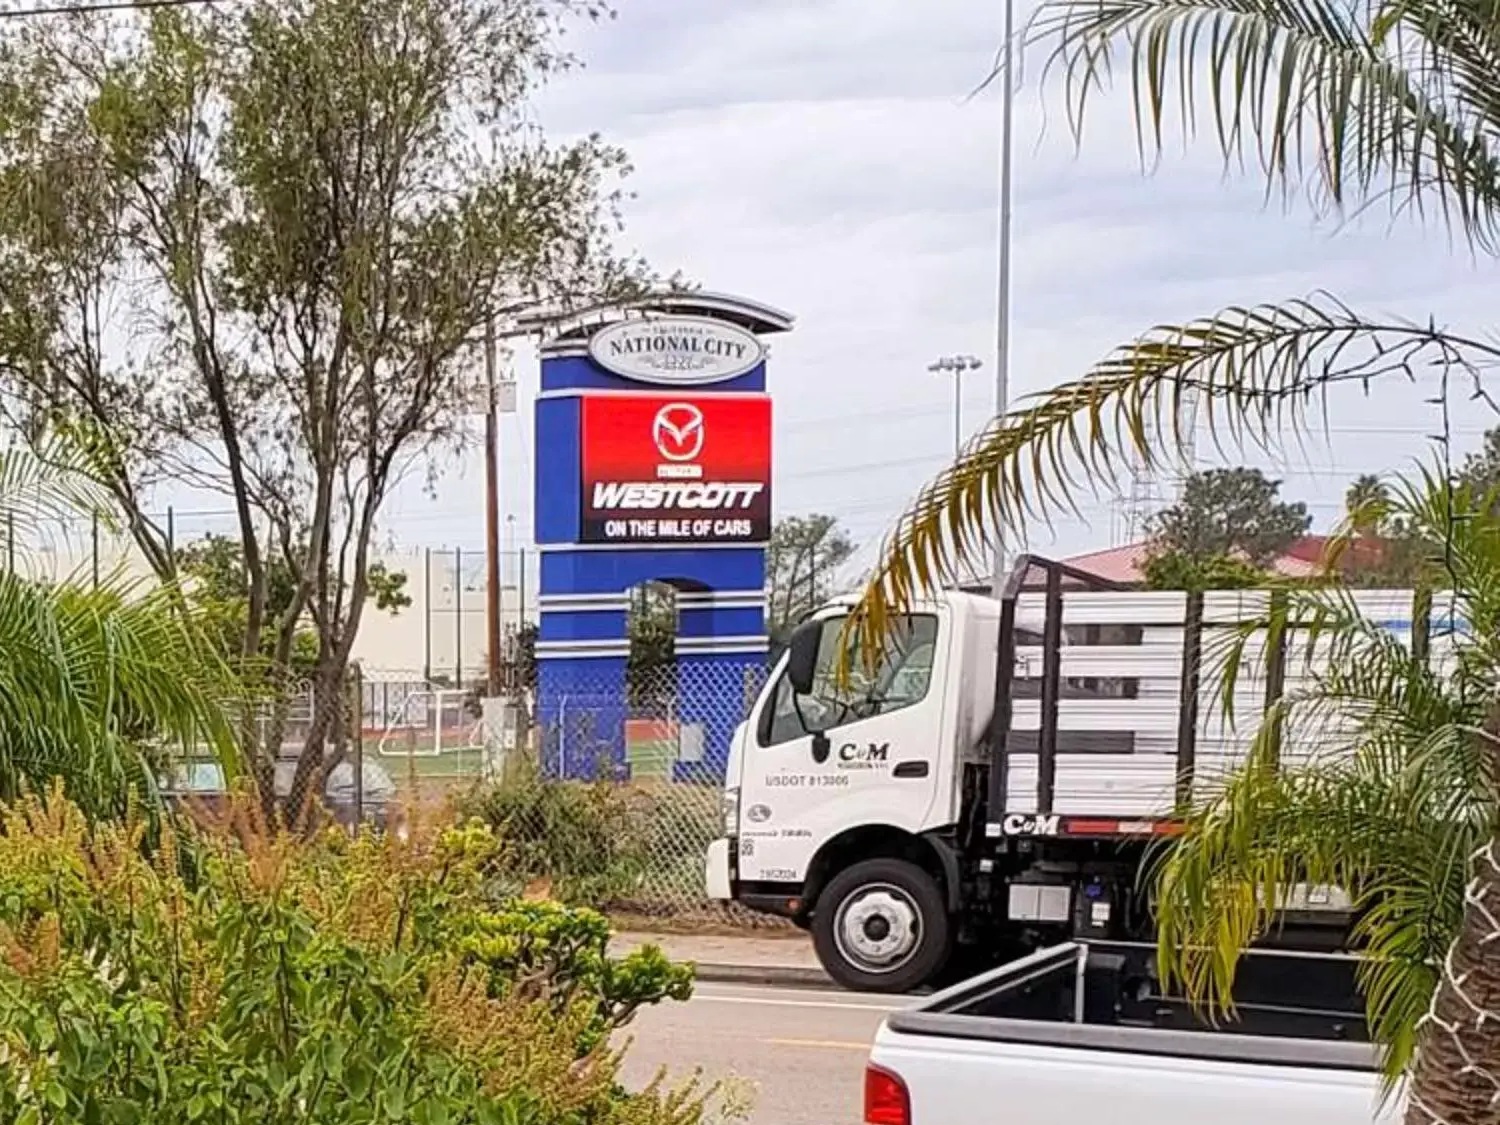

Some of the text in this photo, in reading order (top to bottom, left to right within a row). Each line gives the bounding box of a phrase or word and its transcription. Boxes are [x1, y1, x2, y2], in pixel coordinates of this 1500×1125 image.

[610, 335, 746, 359] NATIONAL CITY
[592, 482, 764, 510] WESTCOTT
[605, 519, 751, 537] ON THE MILE OF CARS
[765, 775, 806, 787] USDOT
[1003, 814, 1061, 835] C&M
